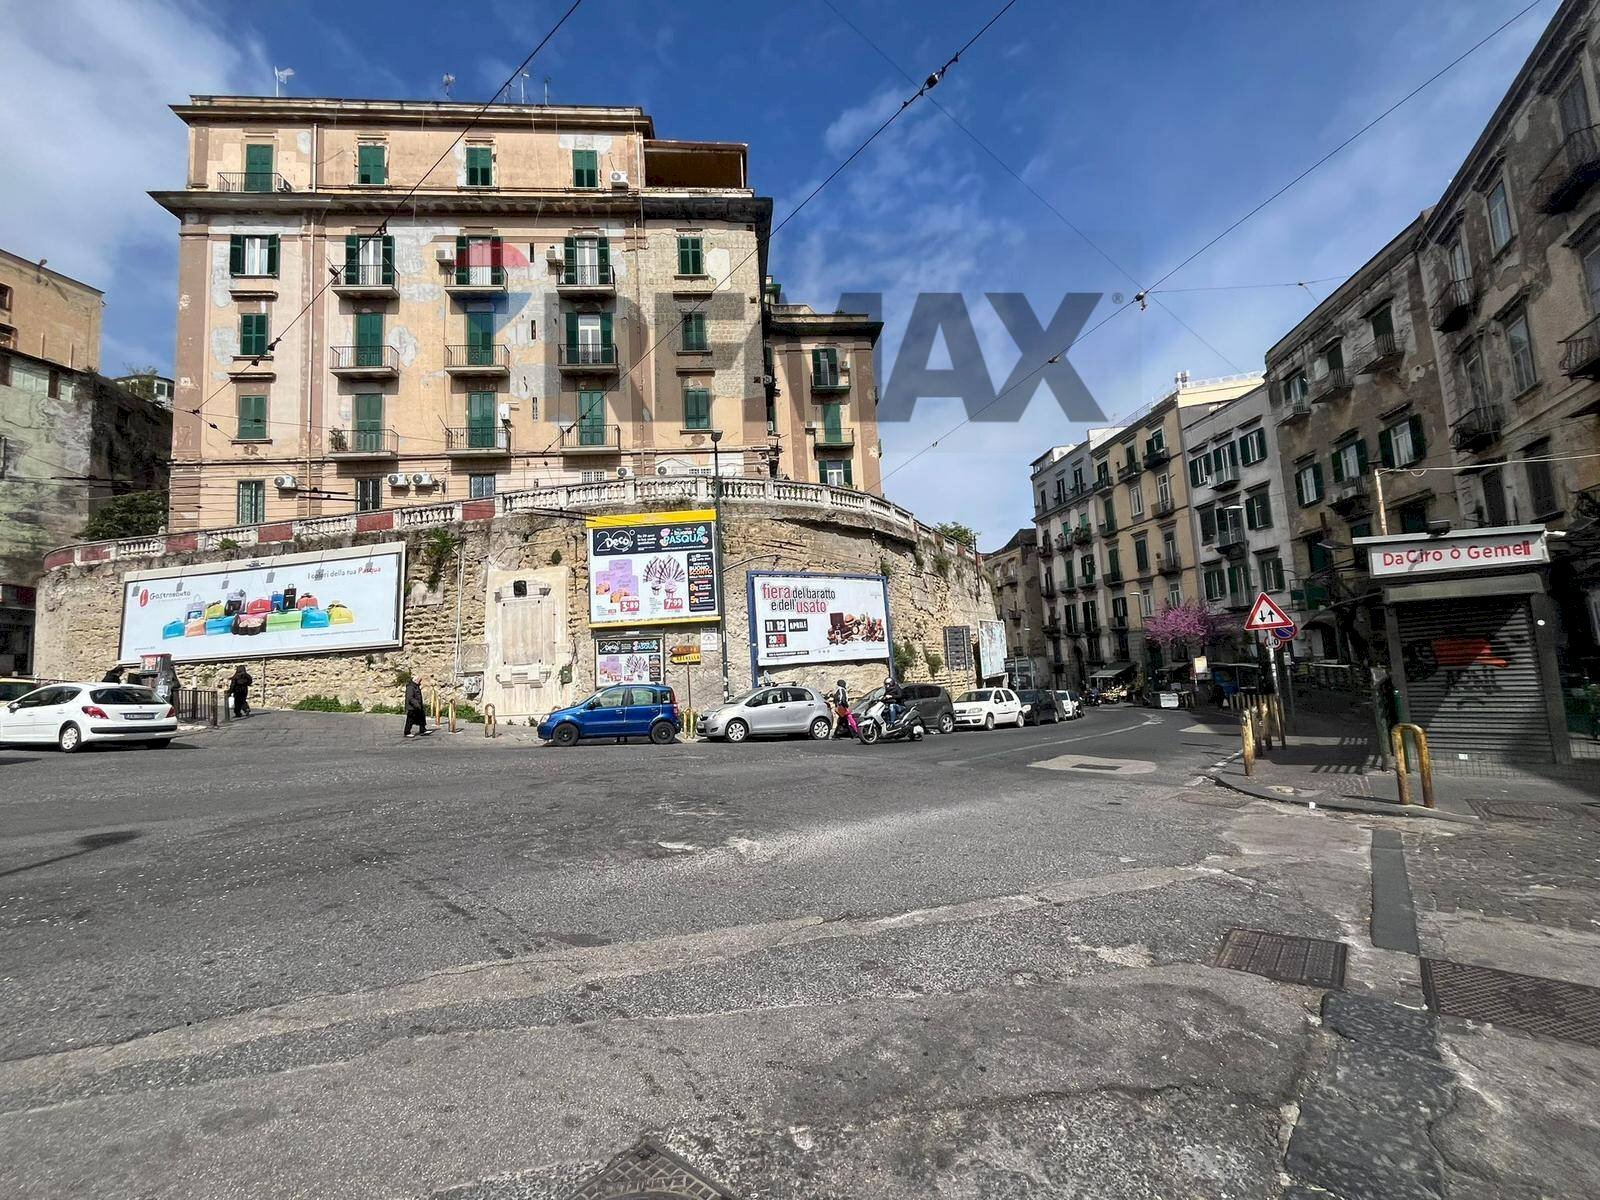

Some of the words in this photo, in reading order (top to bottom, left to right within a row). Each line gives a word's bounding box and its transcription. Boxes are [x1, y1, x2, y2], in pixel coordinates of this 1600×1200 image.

[664, 534, 704, 544] PASQUA
[1383, 552, 1404, 566] Da
[1406, 549, 1443, 563] Ciro
[762, 583, 791, 599] fiera
[792, 588, 805, 599] del
[806, 588, 836, 600] baratto
